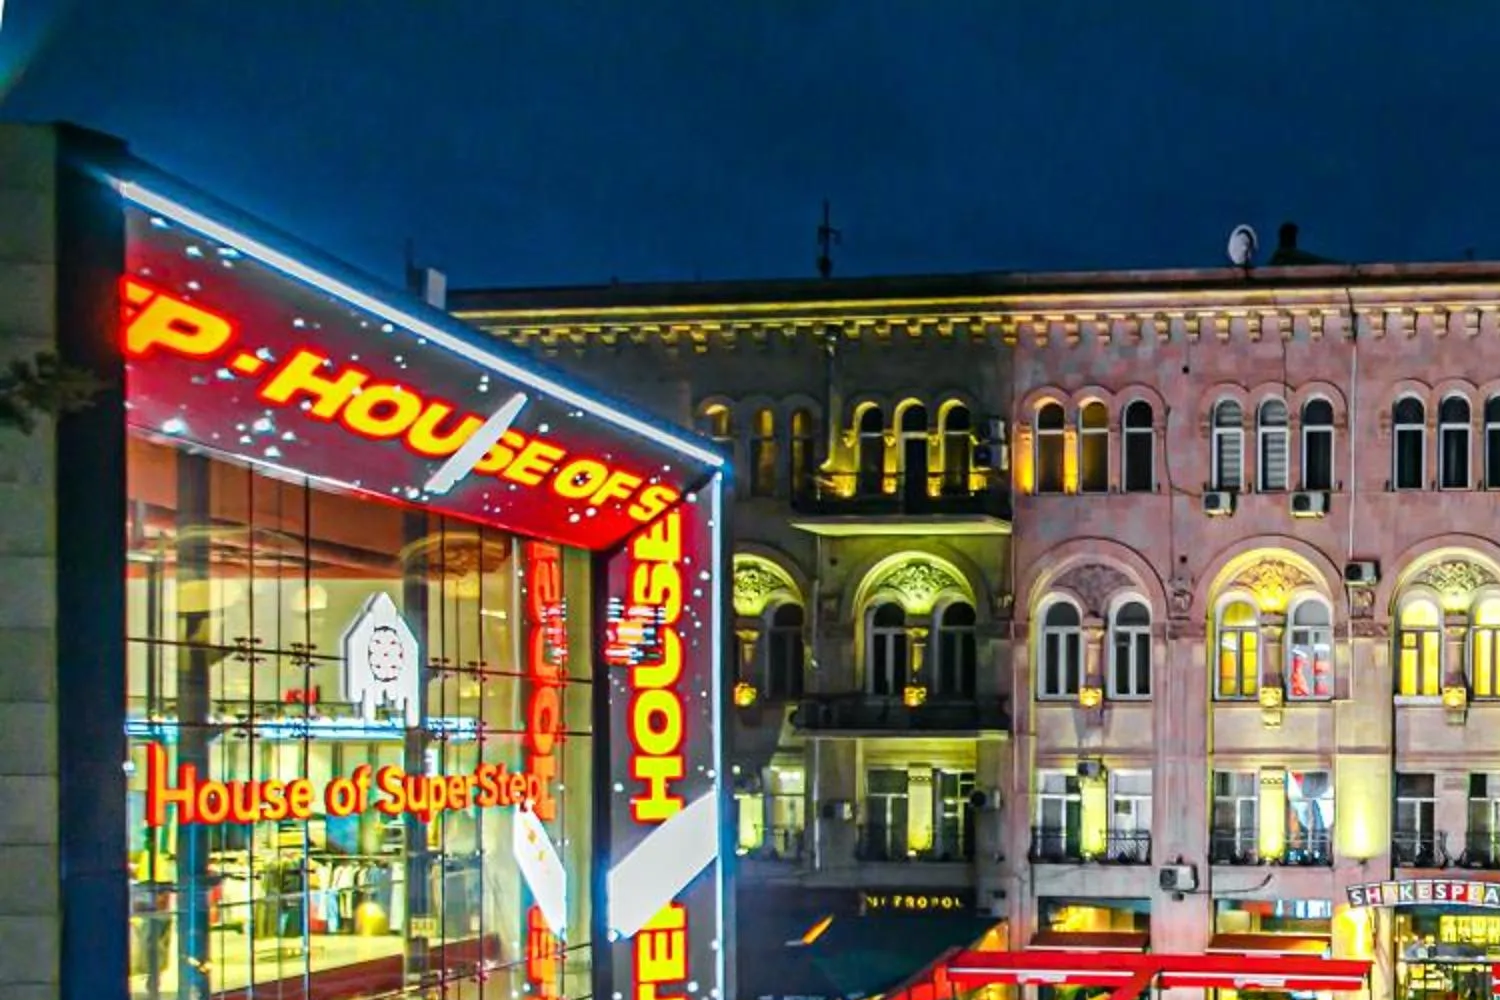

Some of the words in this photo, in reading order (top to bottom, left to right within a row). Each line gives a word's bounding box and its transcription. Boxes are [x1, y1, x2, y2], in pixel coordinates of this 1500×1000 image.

[123, 282, 233, 355] P
[261, 350, 567, 486] HOUSE
[553, 459, 641, 506] OF
[147, 741, 313, 827] House
[325, 764, 372, 816] of
[375, 762, 551, 823] SuperStep
